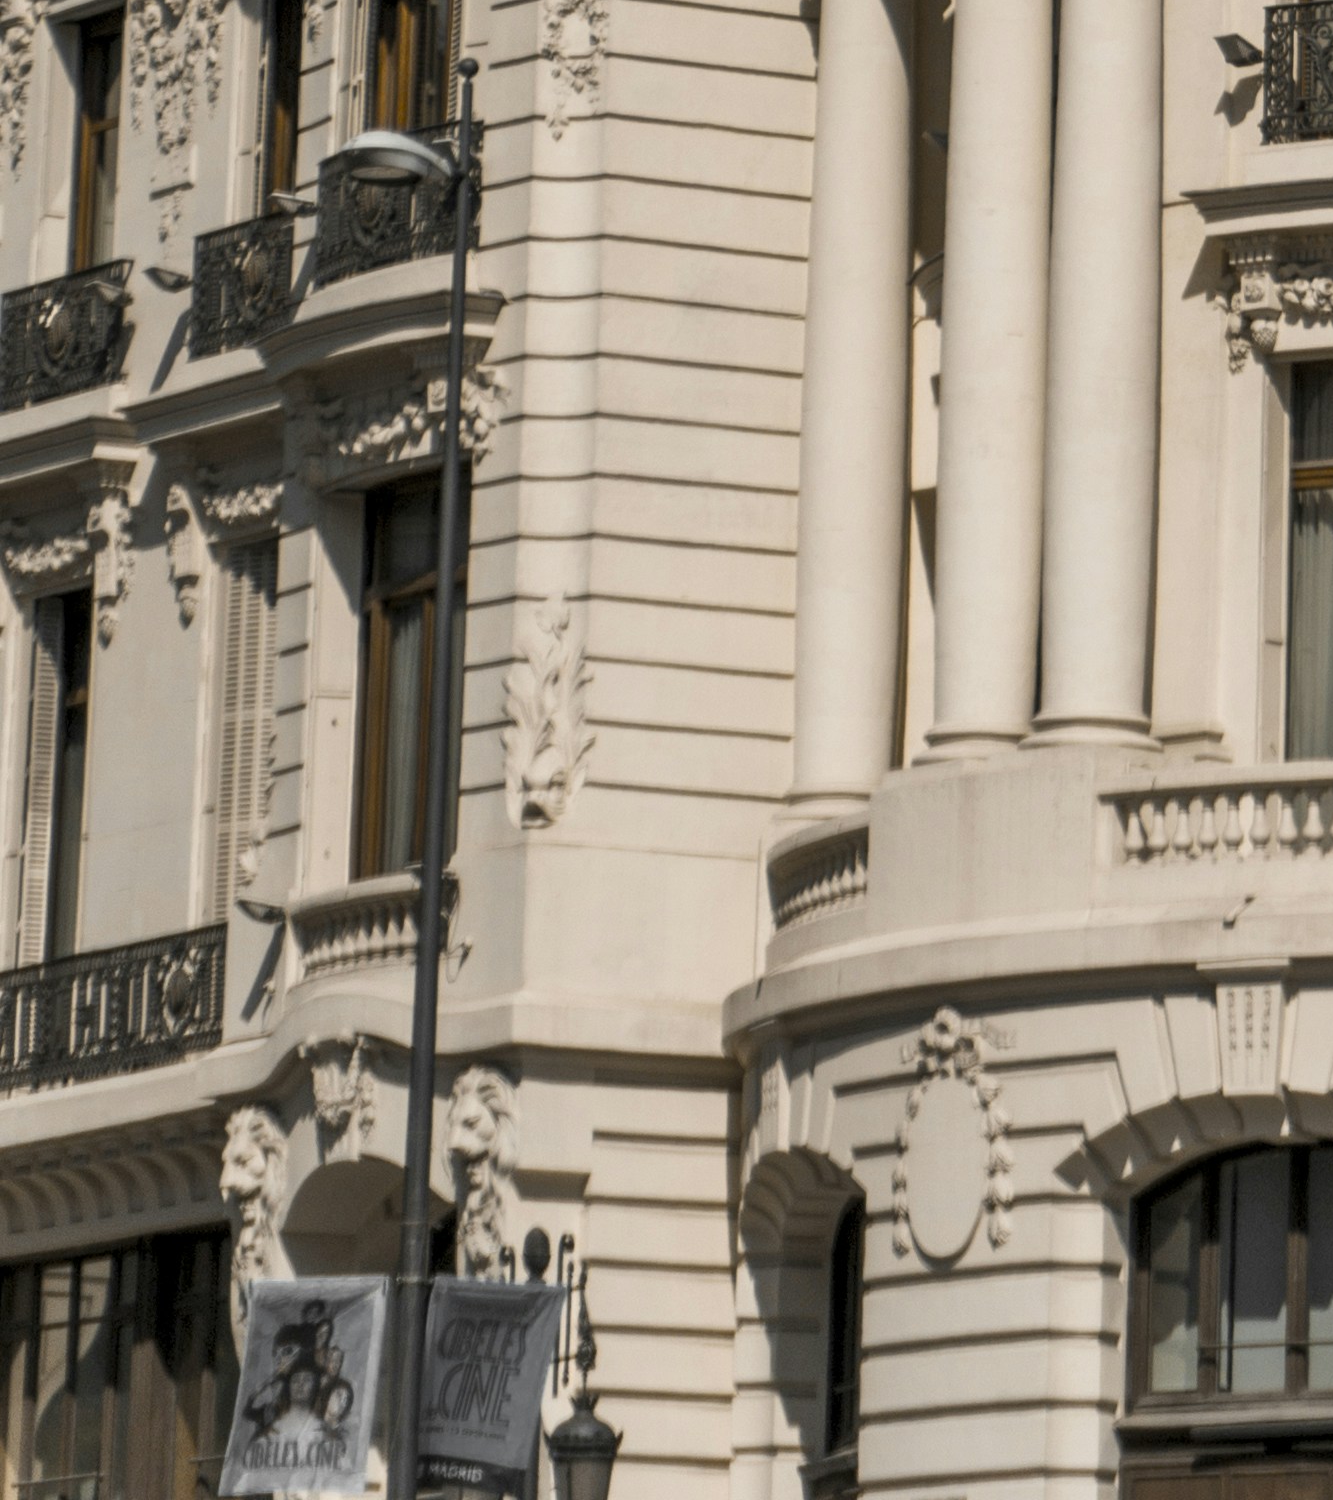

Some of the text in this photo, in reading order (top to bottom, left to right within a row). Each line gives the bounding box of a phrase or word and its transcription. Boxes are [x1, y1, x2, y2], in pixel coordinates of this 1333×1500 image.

[437, 1317, 530, 1366] CIBELES
[438, 1362, 521, 1428] CINE
[305, 1440, 346, 1470] CINE
[429, 1460, 484, 1484] MADRID
